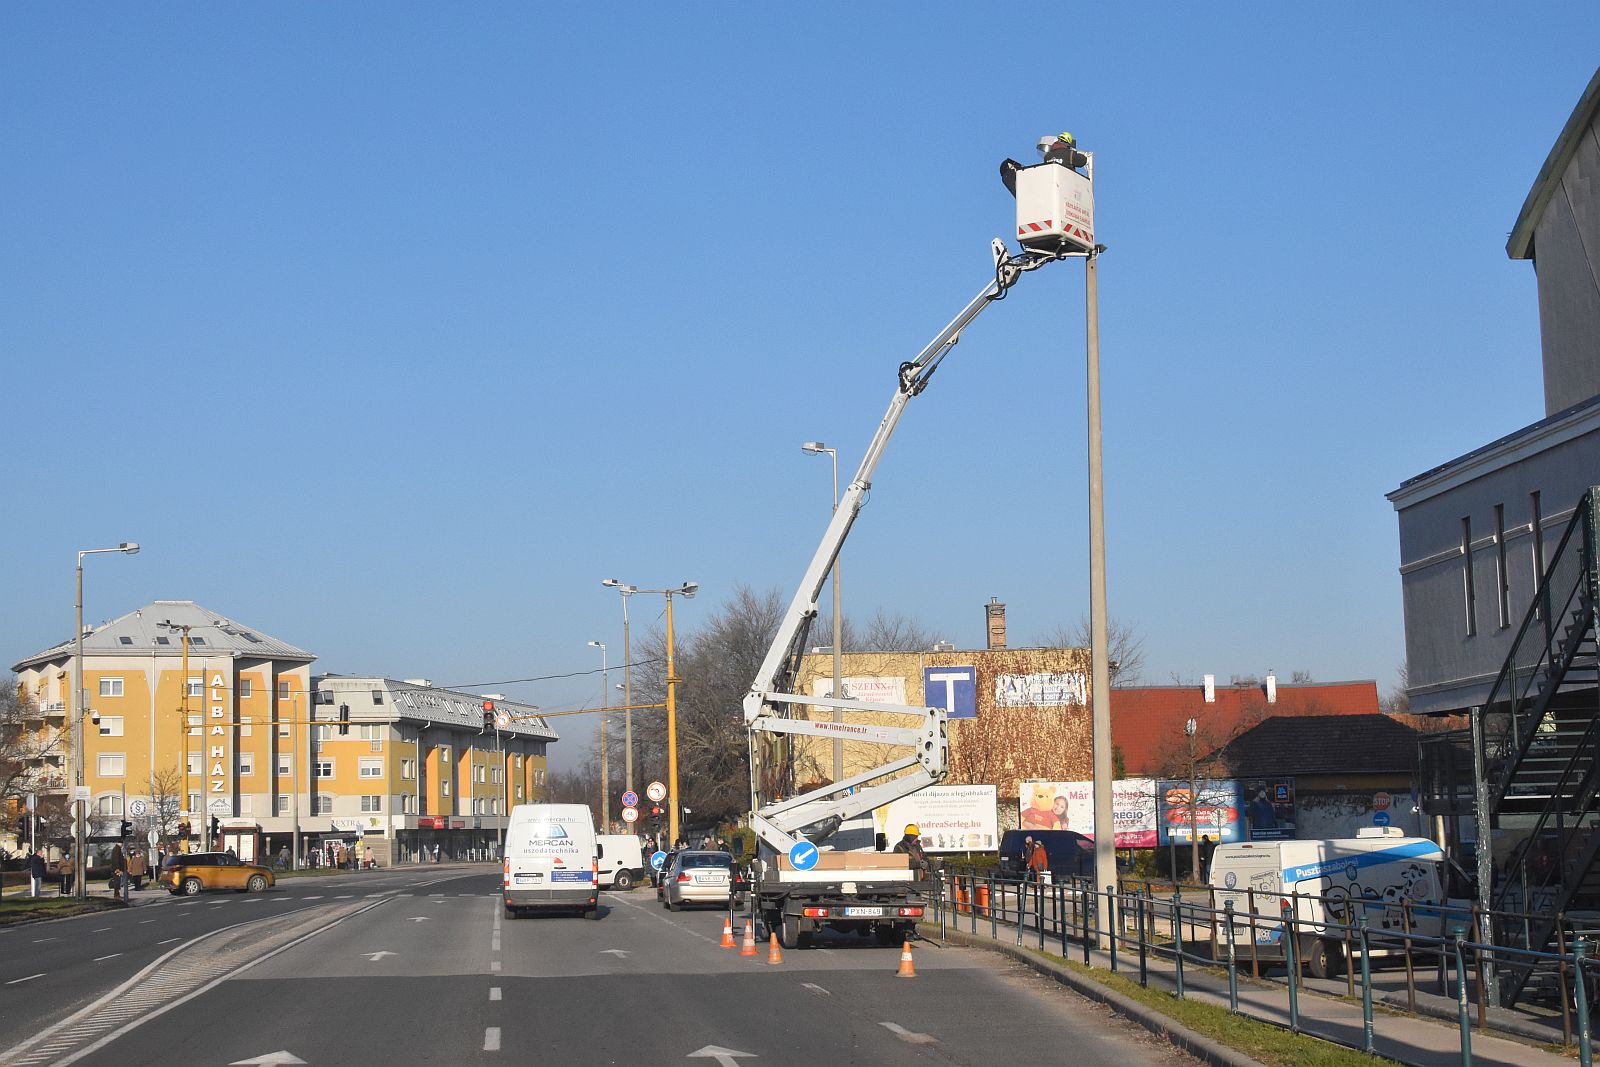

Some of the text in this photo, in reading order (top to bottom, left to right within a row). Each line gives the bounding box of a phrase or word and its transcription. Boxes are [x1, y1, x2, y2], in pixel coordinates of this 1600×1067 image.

[211, 674, 225, 735] ALBA
[211, 745, 225, 792] HÁZ
[1069, 790, 1089, 800] Már
[1374, 797, 1390, 806] STOP
[1113, 811, 1143, 819] REGIO
[916, 820, 981, 830] AndreaSerleg.hu
